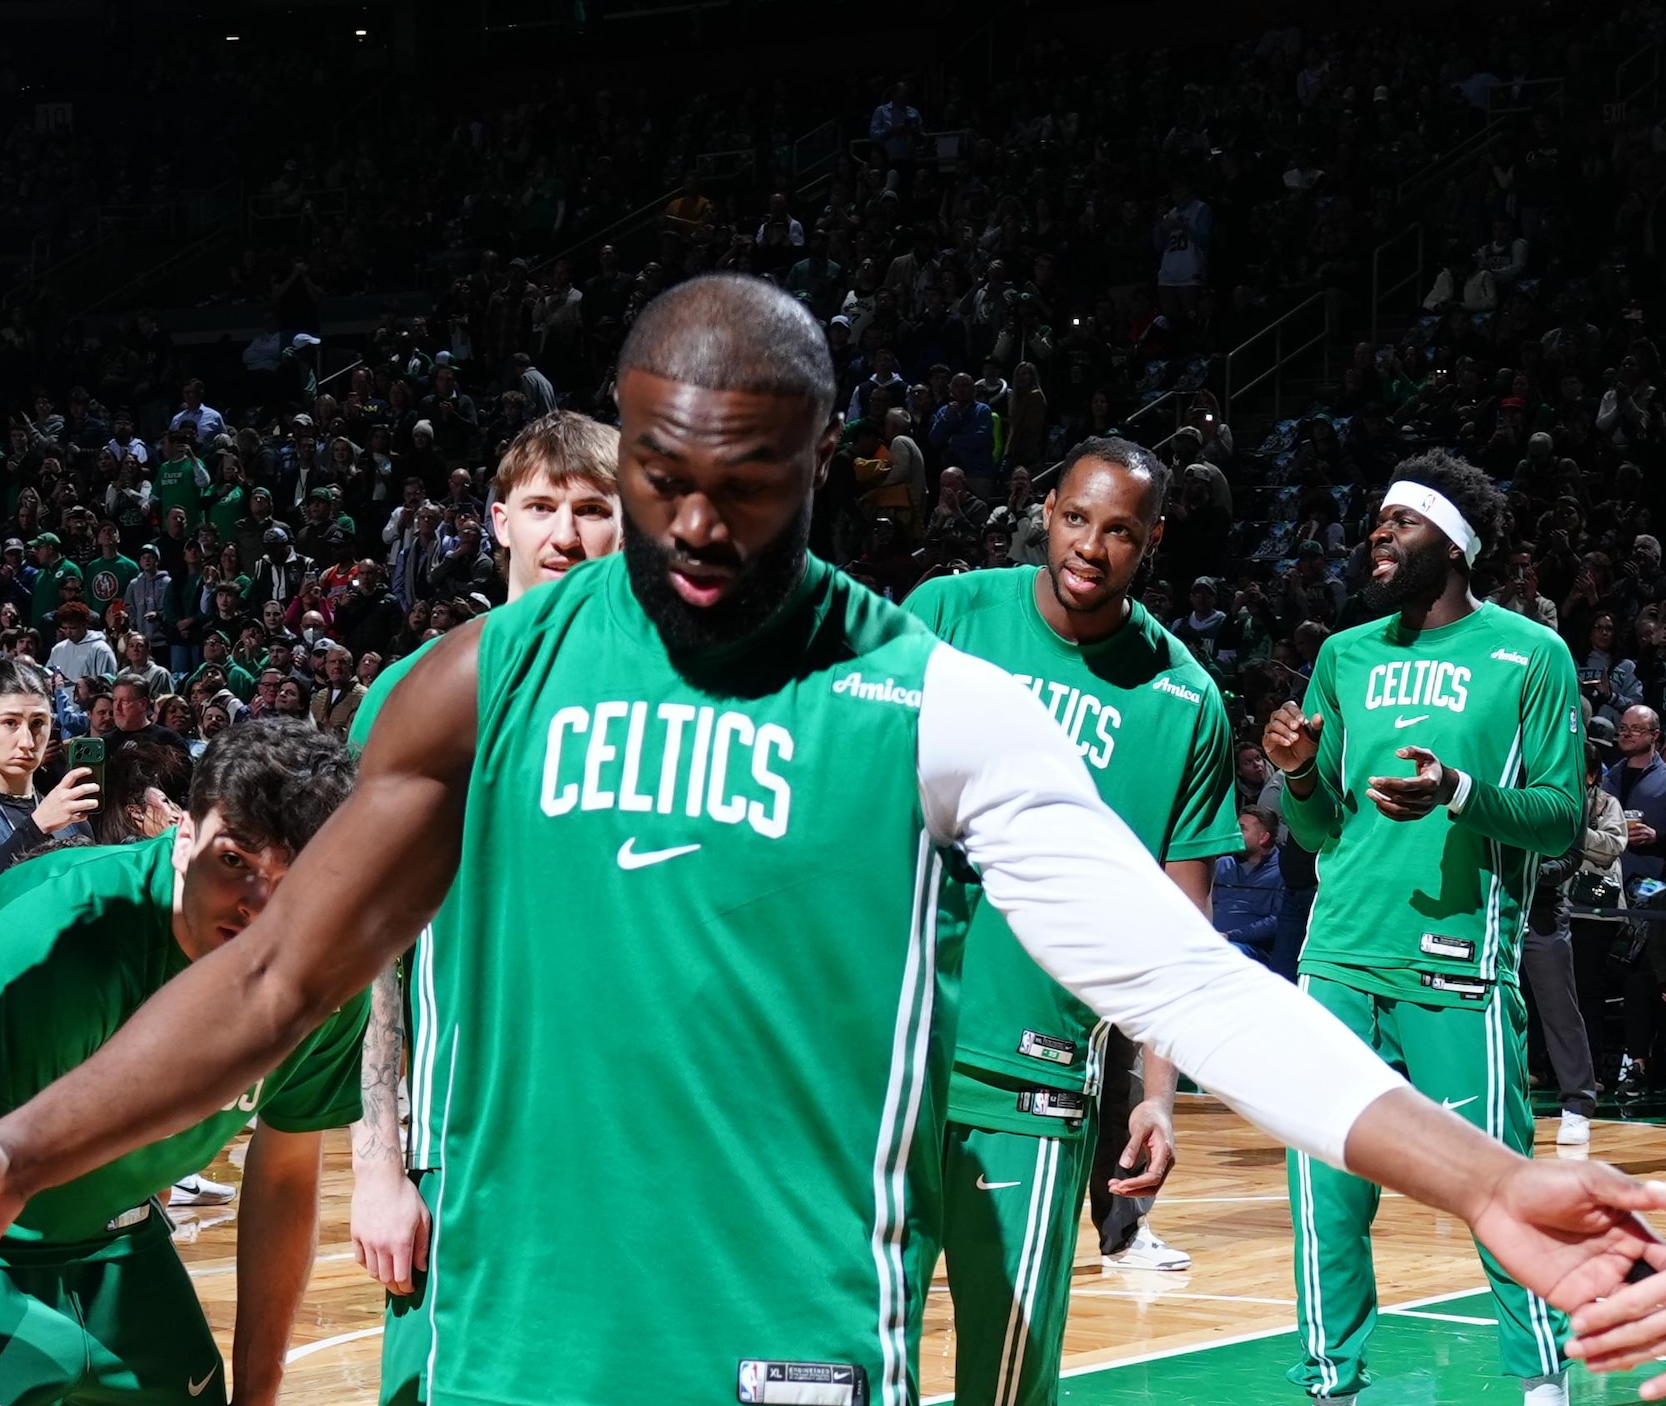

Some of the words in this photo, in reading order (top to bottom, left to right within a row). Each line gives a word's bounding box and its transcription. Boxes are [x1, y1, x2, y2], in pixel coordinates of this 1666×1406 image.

[1491, 649, 1529, 666] Amica
[833, 672, 922, 708] Amica
[1152, 676, 1201, 705] Amica
[1365, 660, 1472, 713] CELTICS
[540, 701, 795, 839] CELTICS
[769, 1368, 783, 1379] XL
